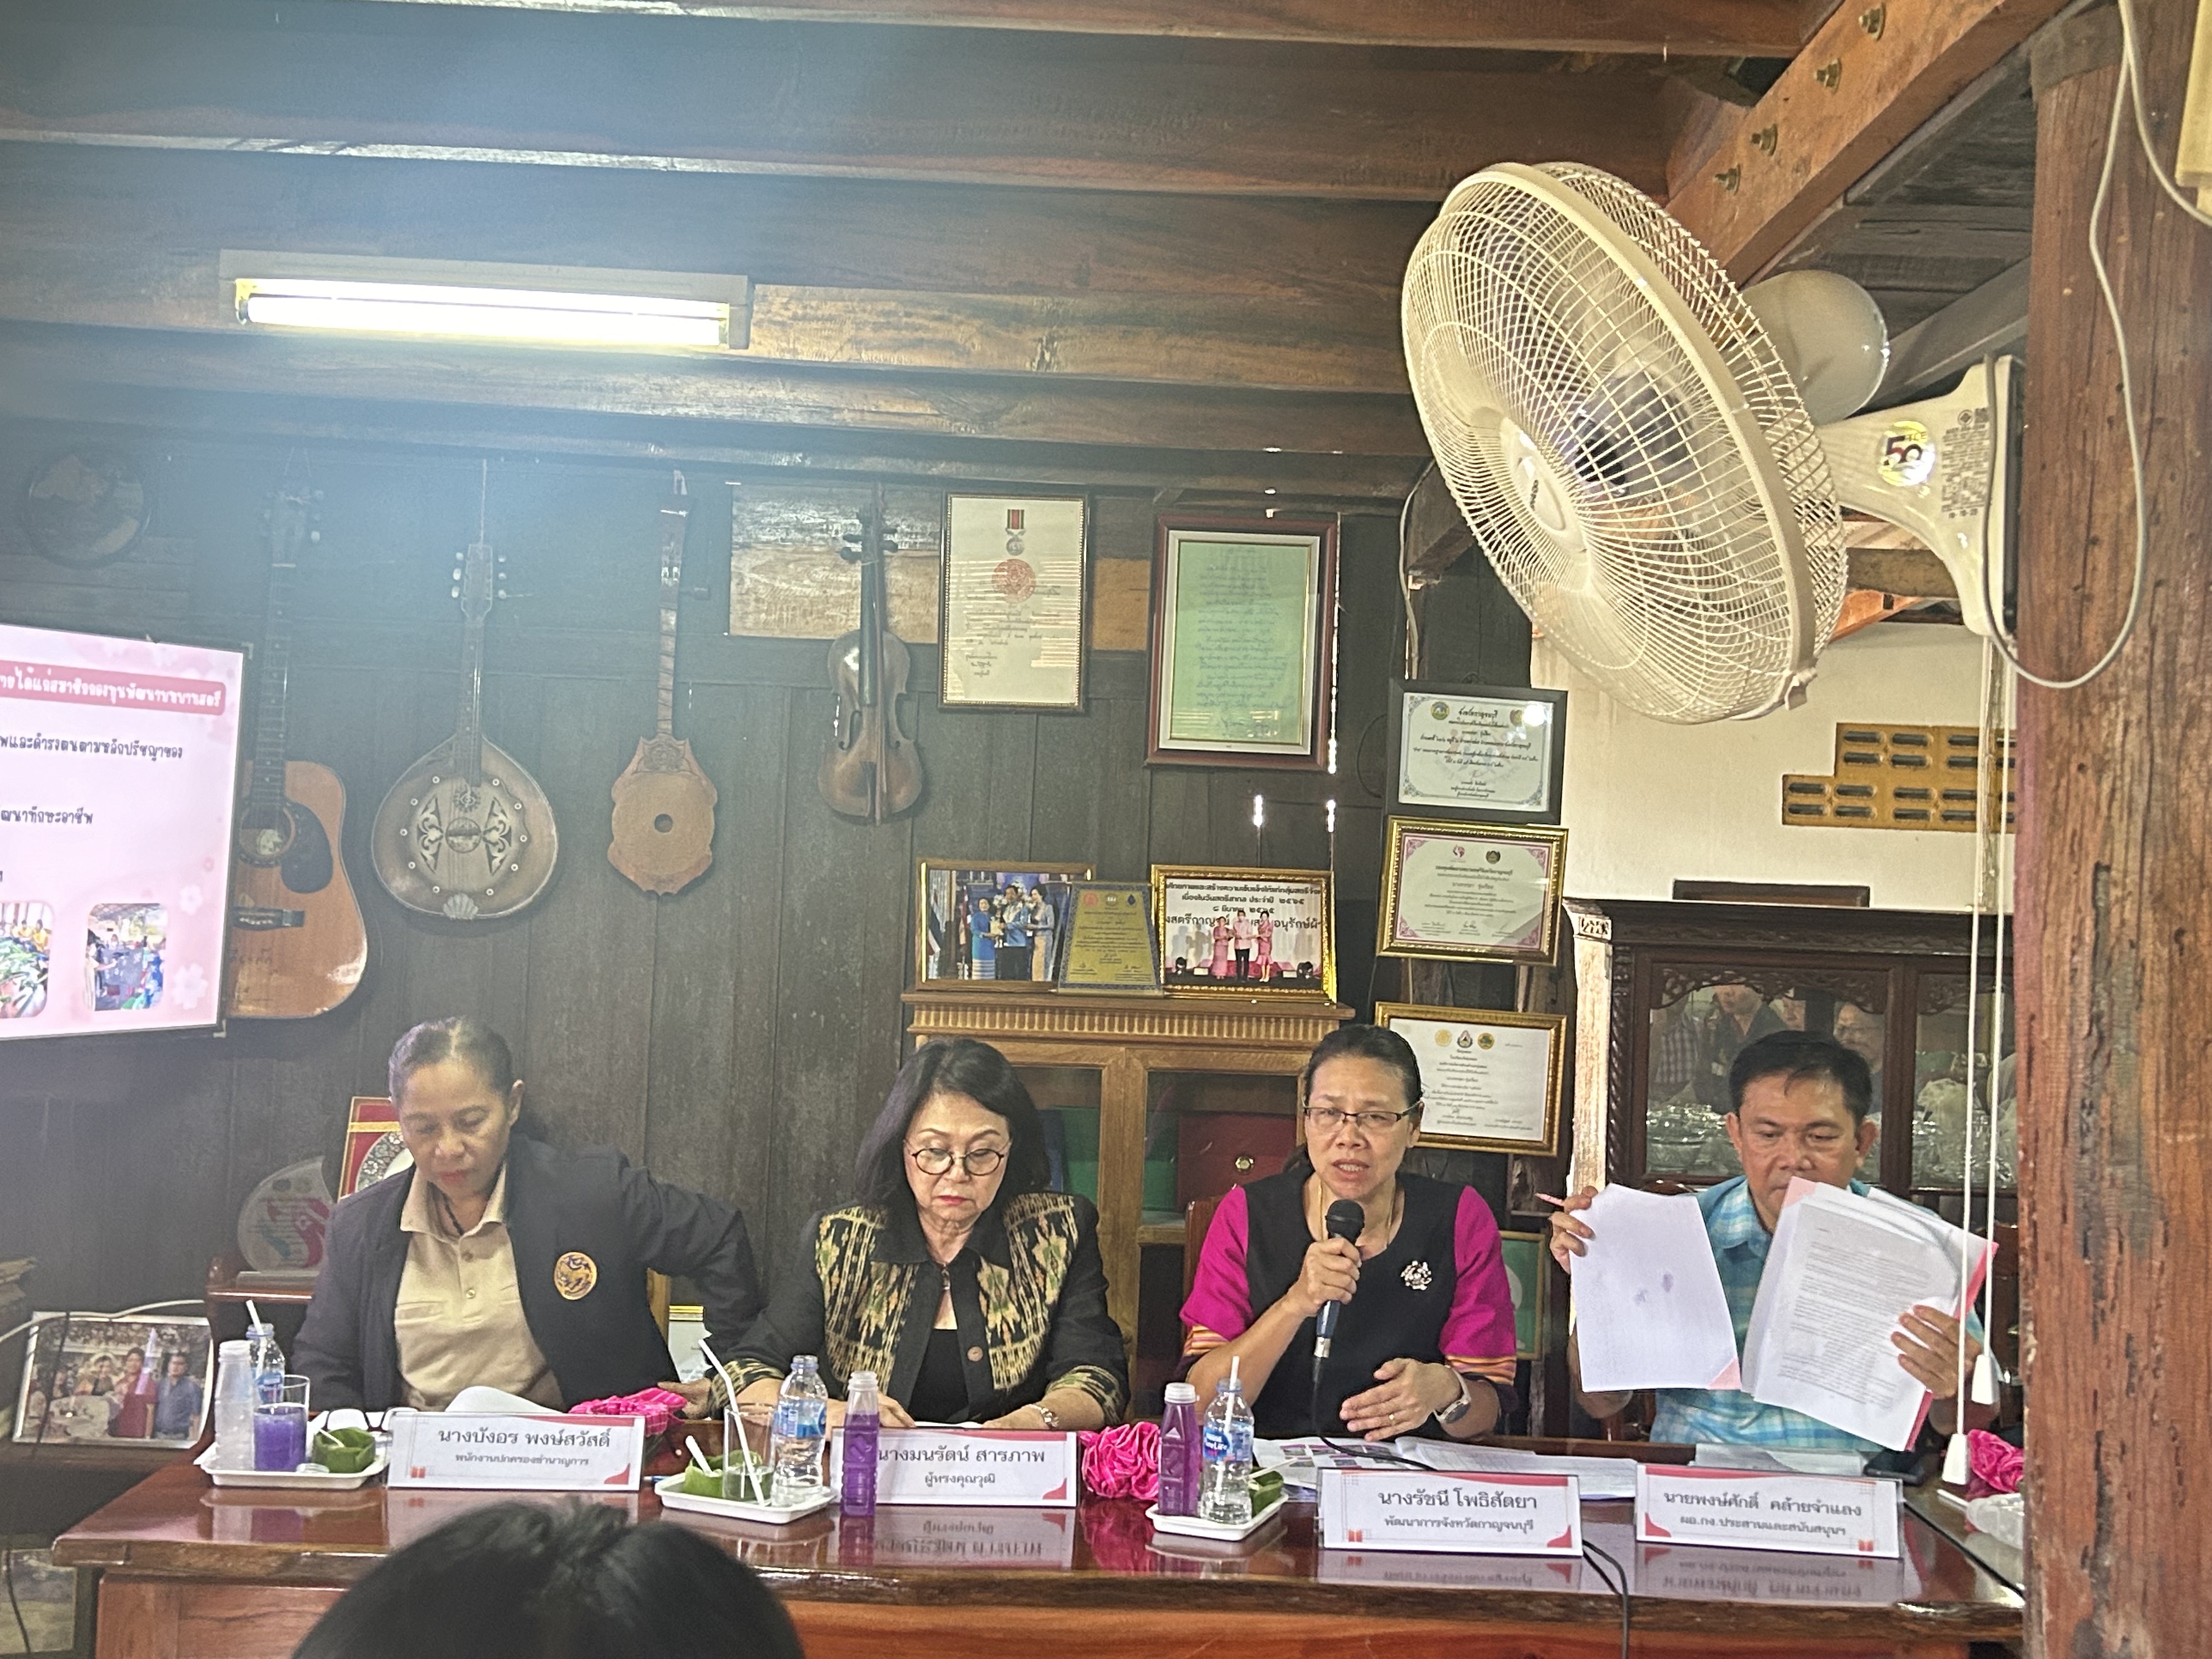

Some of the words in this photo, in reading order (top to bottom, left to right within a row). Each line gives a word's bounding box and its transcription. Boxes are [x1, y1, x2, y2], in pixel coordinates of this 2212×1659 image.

[438, 1427, 518, 1444] นางบังอร
[525, 1427, 611, 1447] พงษ์สวัสดิ์
[977, 1447, 1045, 1463] สารภาพ
[925, 1472, 995, 1487] ผู้ทรงคุณวุฒิ
[1378, 1489, 1448, 1506] นางรัชนี
[1454, 1488, 1537, 1509] โพธิสัตยา
[1664, 1492, 1759, 1509] นายพงษ์ศักดิ์
[1385, 1516, 1534, 1534] พัฒนาการจังหวัดกาญจนบุรี
